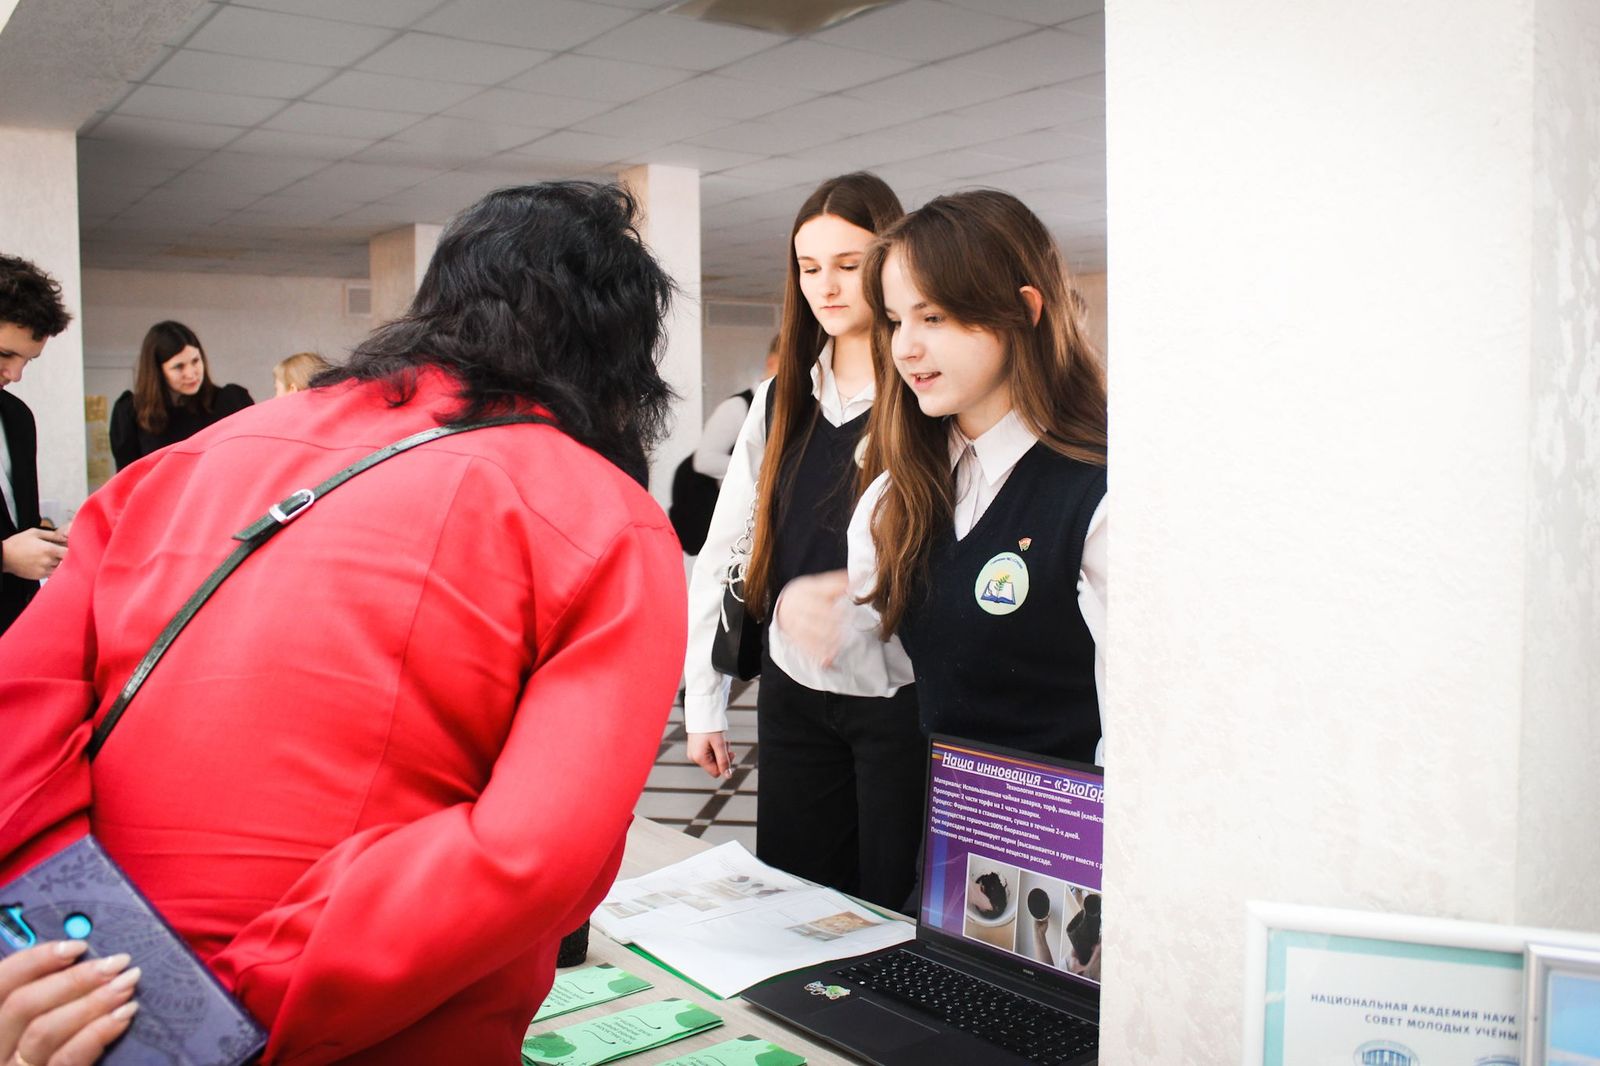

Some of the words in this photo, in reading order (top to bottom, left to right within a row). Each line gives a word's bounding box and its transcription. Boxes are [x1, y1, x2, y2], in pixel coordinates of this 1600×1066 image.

[942, 752, 974, 771] Наша
[976, 762, 1041, 786] инновация
[934, 776, 962, 788] Материалы:
[963, 784, 1001, 798] Использованная
[1002, 794, 1020, 802] чайная
[1020, 799, 1042, 809] заварка,
[1043, 803, 1058, 813] торф,
[1006, 783, 1034, 794] Технология
[954, 802, 977, 813] Формовка
[982, 810, 1013, 823] стаканчиках,
[1014, 818, 1029, 826] сушка
[1034, 823, 1056, 833] течение
[978, 798, 993, 807] торфа
[1005, 806, 1018, 814] часть
[1019, 809, 1040, 819] заварки.
[931, 827, 957, 839] Постепенно
[1006, 848, 1029, 859] вещества
[942, 820, 965, 831] пересадке
[1060, 853, 1075, 861] грунт
[1310, 993, 1408, 1012] НАЦИОНАЛЬНАЯ
[1412, 1004, 1478, 1020] АКАДЕМИЯ
[1482, 1012, 1516, 1025] НАУК
[1364, 1014, 1402, 1026] СОВЕТ
[1406, 1018, 1470, 1034] МОЛОДЫХ
